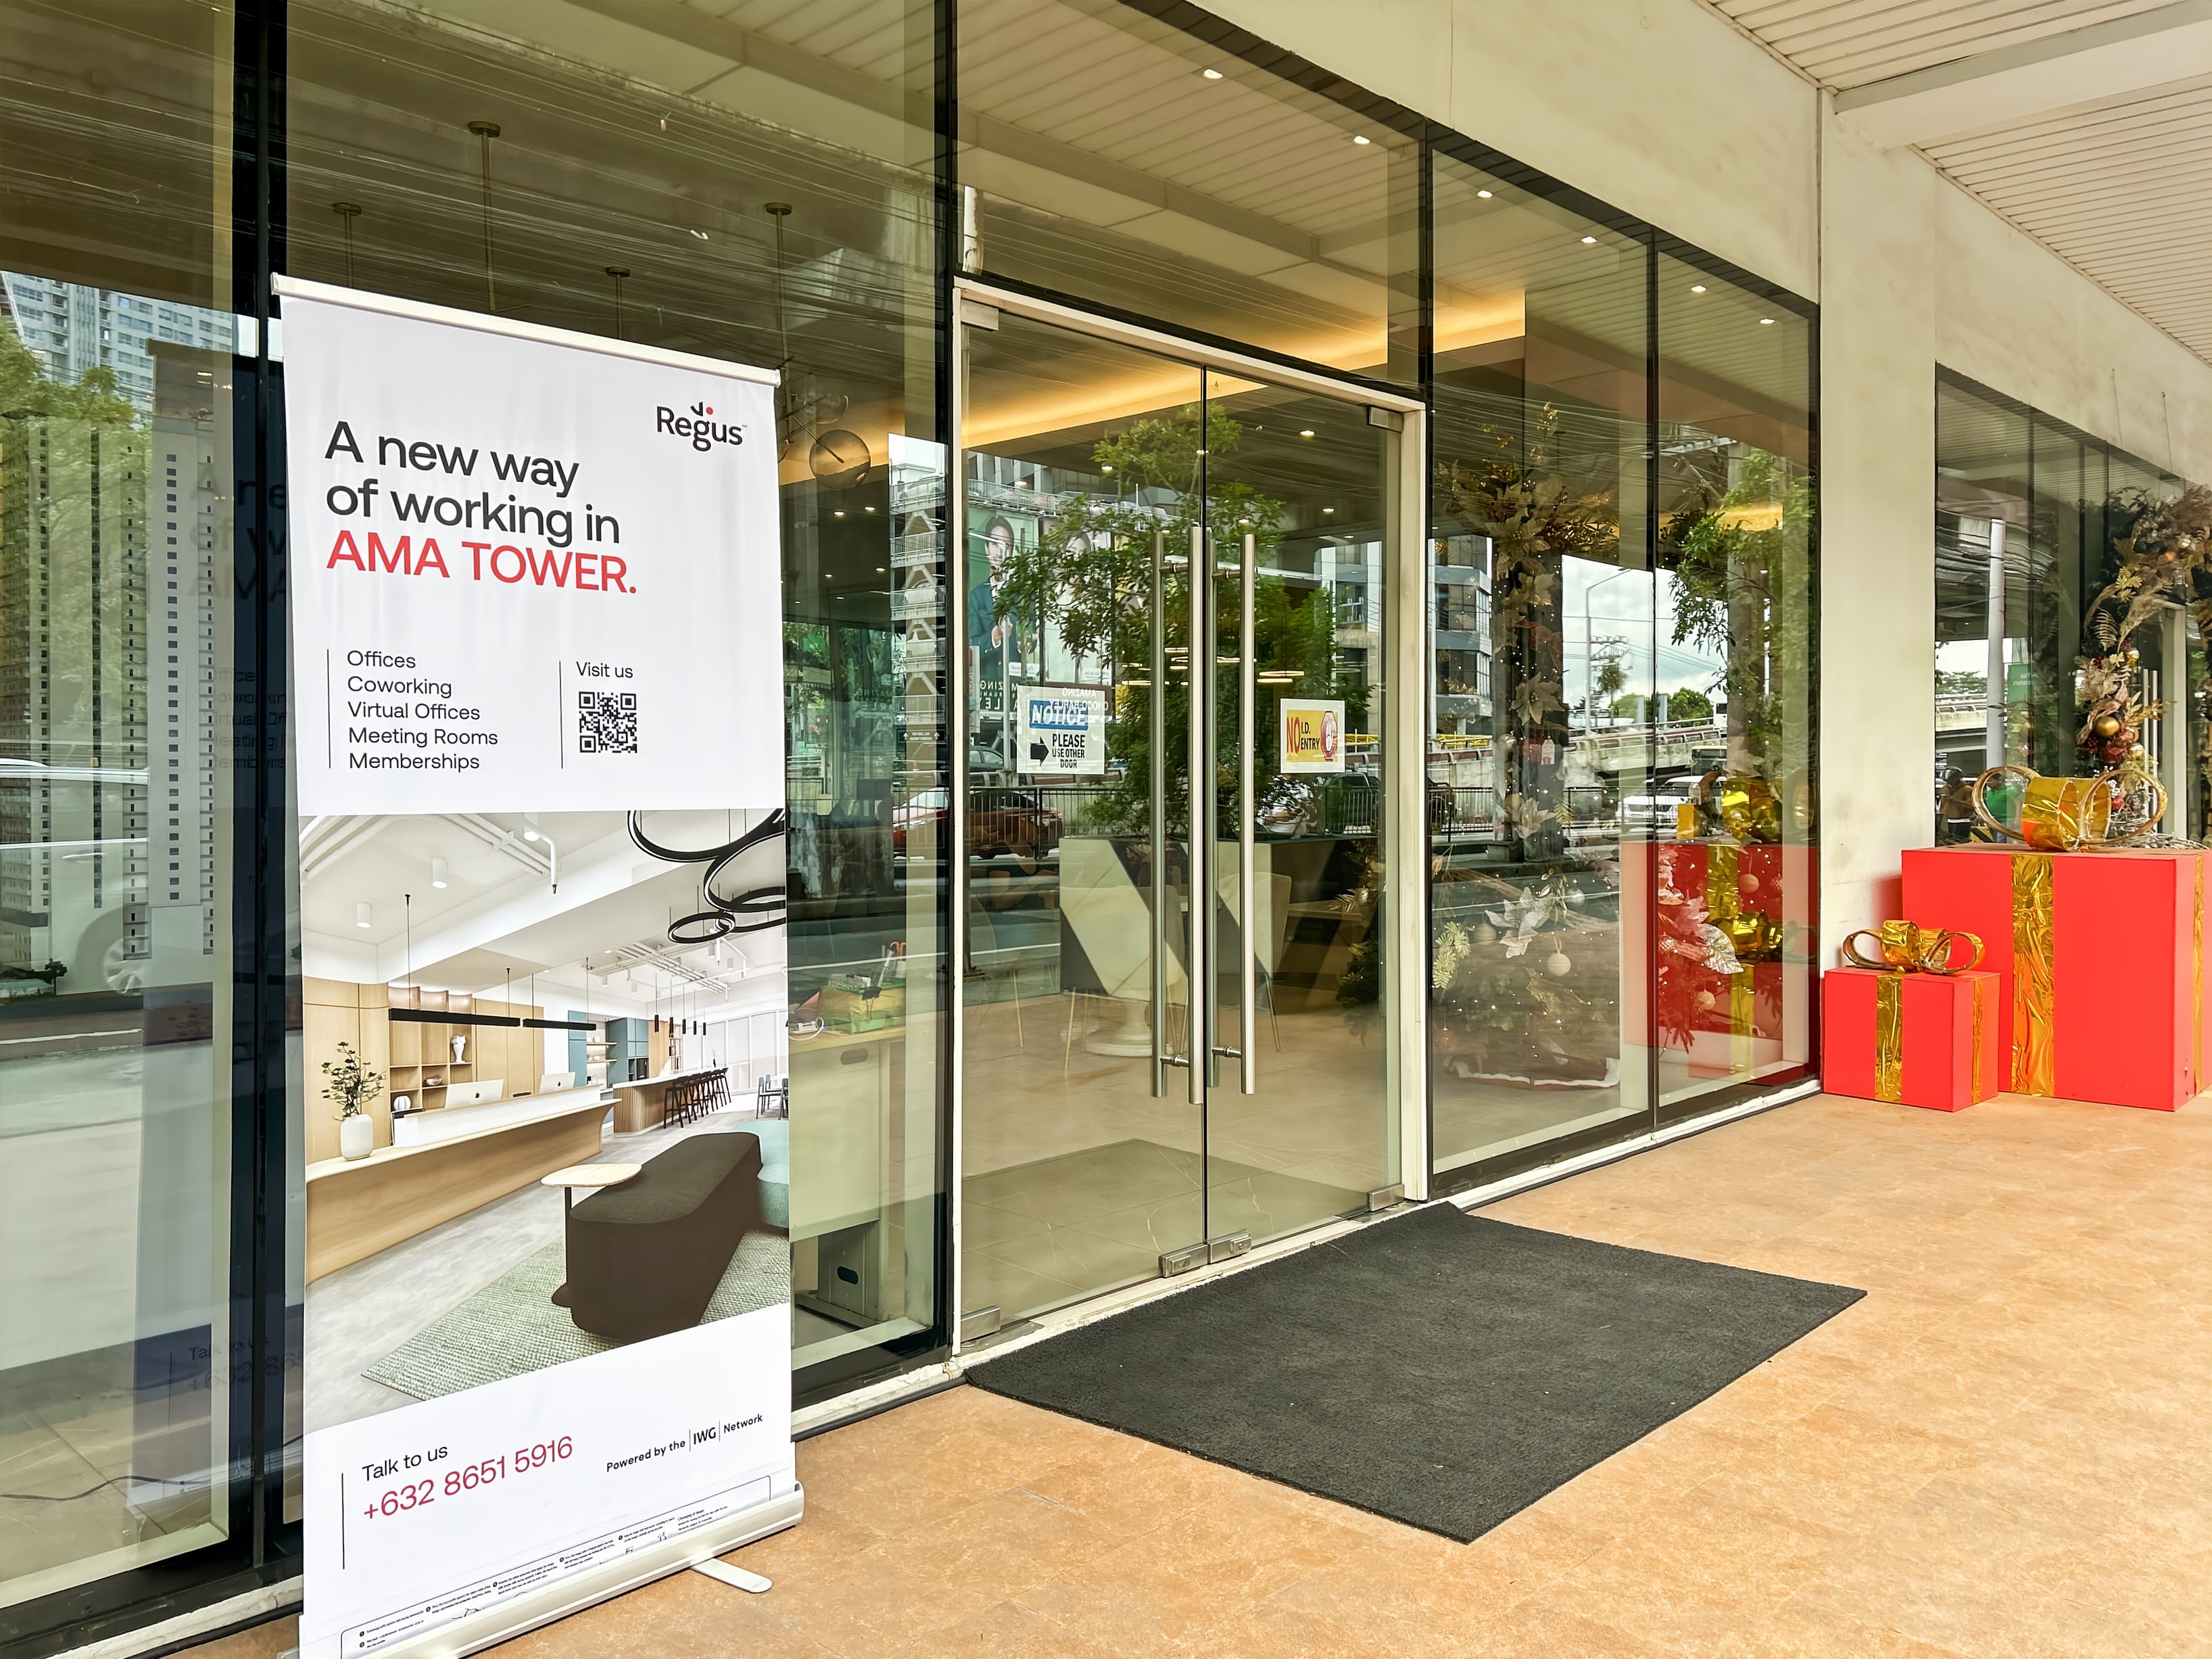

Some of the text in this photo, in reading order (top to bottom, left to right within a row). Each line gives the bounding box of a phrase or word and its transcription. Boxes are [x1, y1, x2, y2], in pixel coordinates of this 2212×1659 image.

[657, 402, 742, 452] Regus
[324, 421, 579, 498] A new way
[327, 479, 619, 548] of working in
[327, 530, 450, 577] AMA
[462, 542, 636, 594] TOWER.
[347, 650, 415, 668] Offices
[576, 661, 633, 678] Visit us
[348, 676, 451, 698] Coworking
[348, 702, 479, 719] Virtual Offices
[1032, 704, 1087, 726] NOTICE
[350, 727, 498, 748] Meeting Rooms
[1287, 717, 1301, 754] NO
[1301, 721, 1311, 734] I.D.
[1052, 734, 1086, 748] PLEASE
[1301, 738, 1320, 750] ENTRY
[350, 753, 479, 773] Memberships
[1052, 748, 1085, 759] USE OTHER
[1060, 759, 1078, 769] DOOR
[607, 1414, 763, 1472] Powered by the IWG Network
[362, 1447, 448, 1481] Talk to us
[364, 1437, 572, 1518] +632 8651 5916
